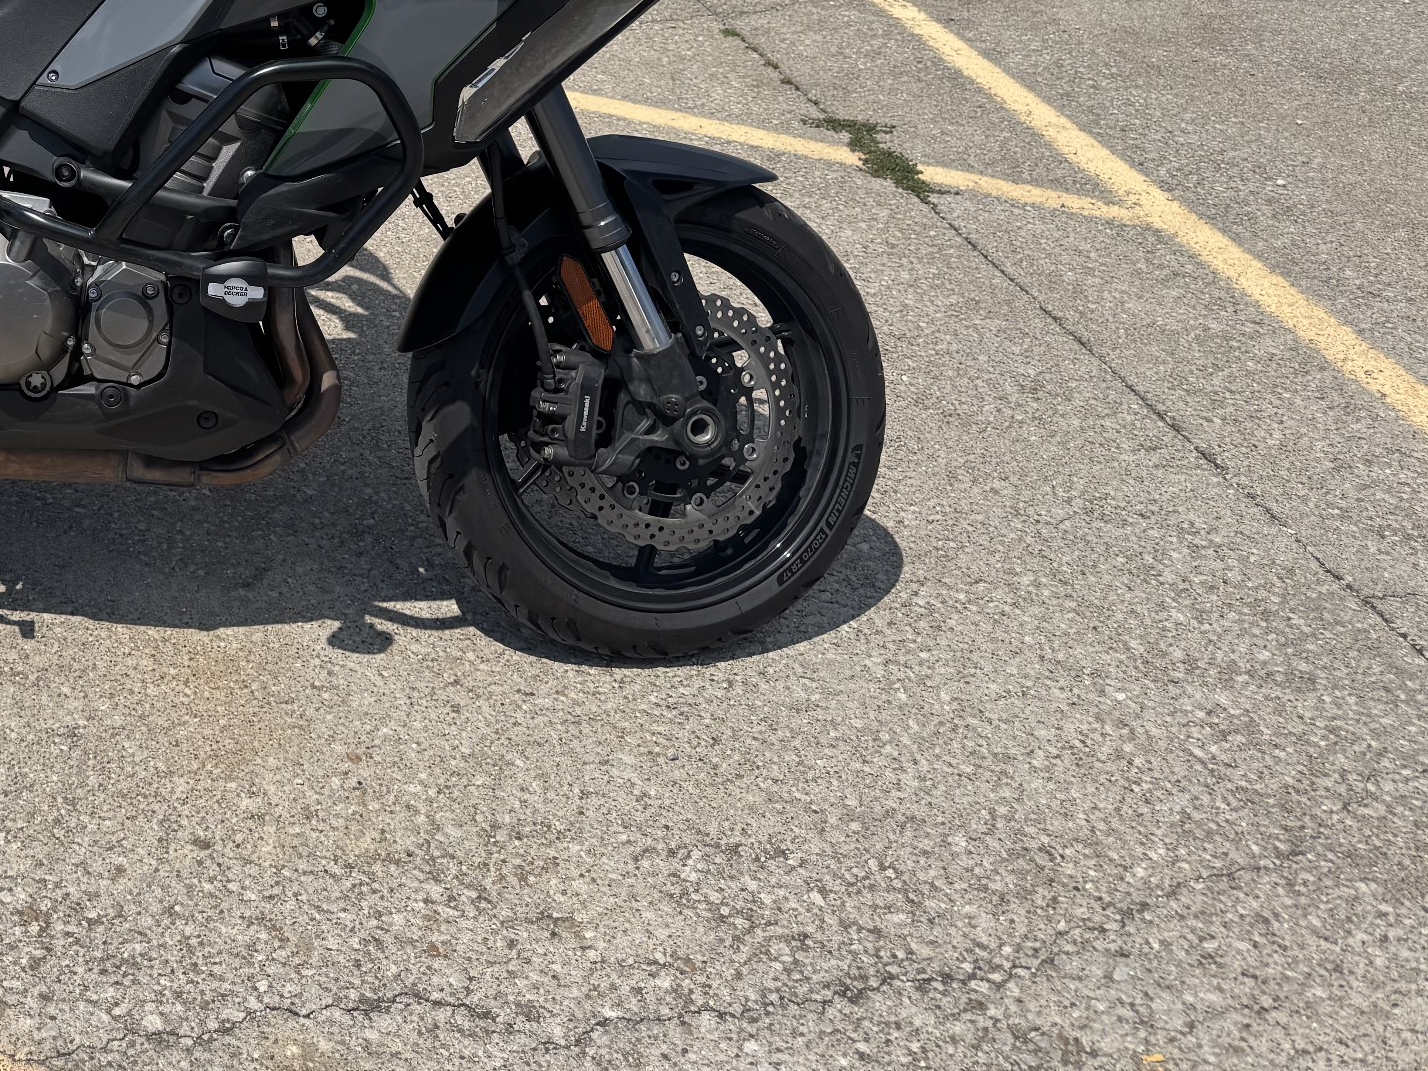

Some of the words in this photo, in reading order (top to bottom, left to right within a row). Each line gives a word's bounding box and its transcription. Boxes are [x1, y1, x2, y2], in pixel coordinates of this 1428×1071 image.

[579, 395, 591, 432] Kawasaki
[826, 461, 857, 526] MICHELIN
[802, 529, 826, 561] 120/70
[782, 570, 792, 581] 17
[790, 558, 803, 573] ZR
